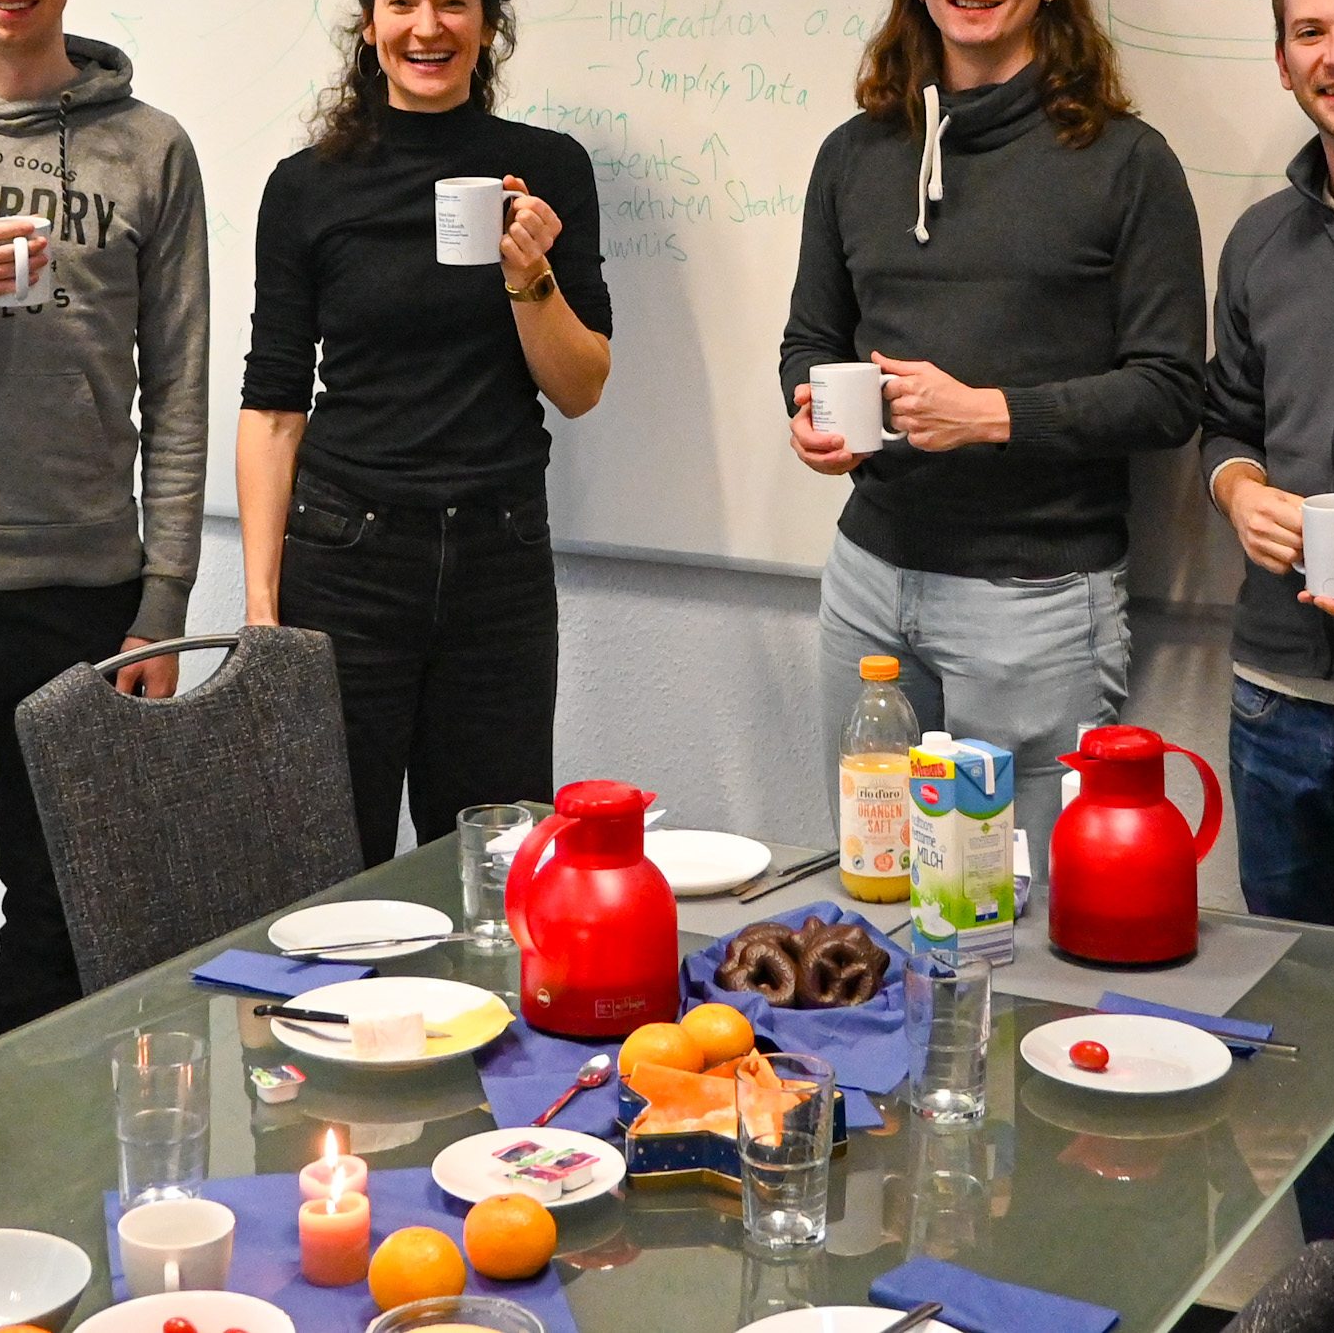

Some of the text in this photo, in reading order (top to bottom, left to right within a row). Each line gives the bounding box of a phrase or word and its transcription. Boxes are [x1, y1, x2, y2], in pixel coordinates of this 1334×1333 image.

[741, 63, 809, 107] Data
[14, 155, 78, 182] GOODS
[725, 179, 805, 223] Startu
[857, 802, 903, 819] ORANGEN
[867, 820, 892, 835] SAFT
[917, 845, 945, 871] MILCH
